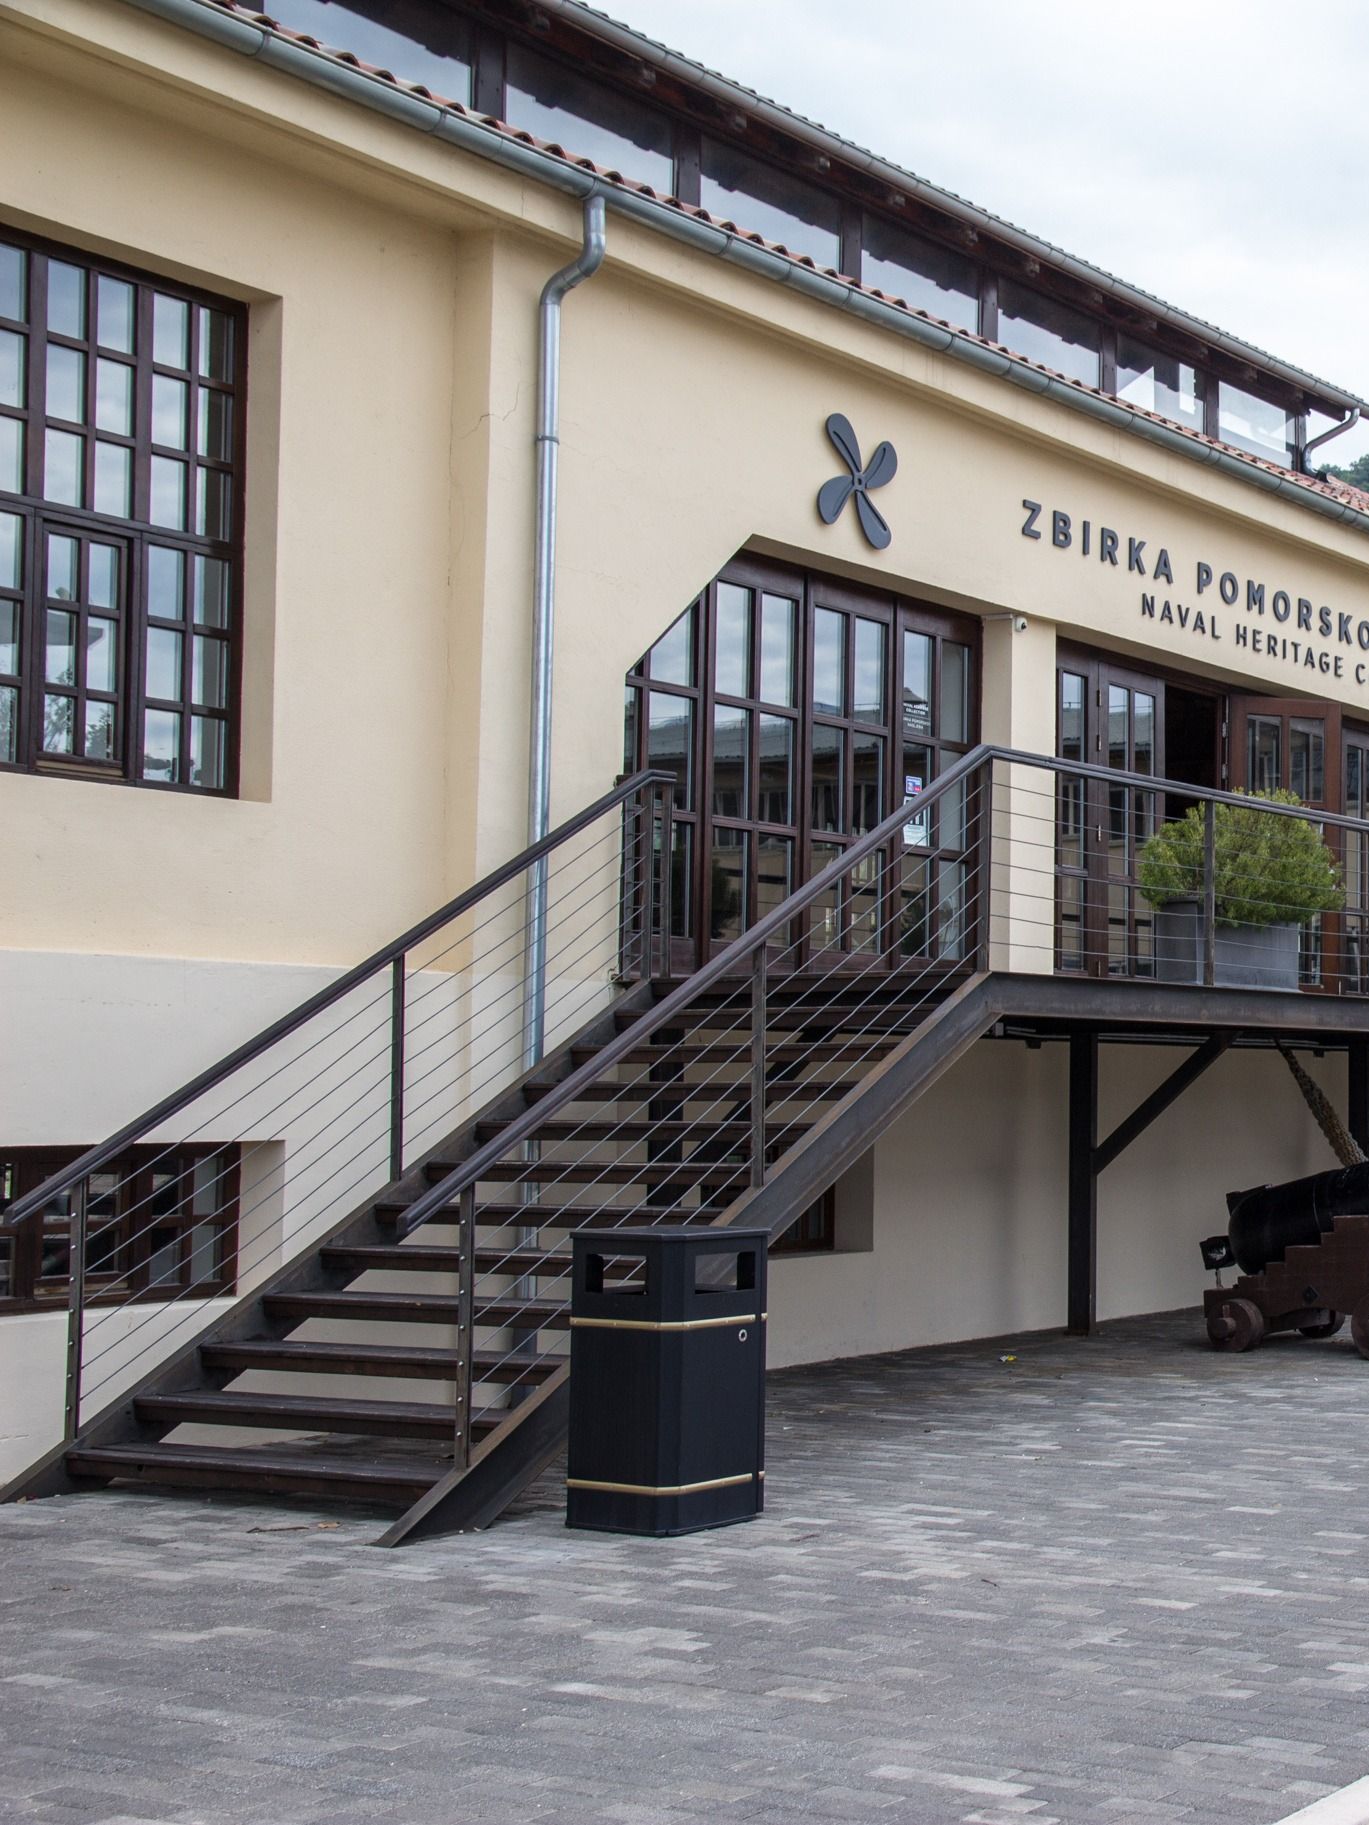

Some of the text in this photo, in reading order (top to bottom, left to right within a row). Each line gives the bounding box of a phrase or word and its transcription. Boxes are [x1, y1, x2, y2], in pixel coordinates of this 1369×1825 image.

[1022, 499, 1174, 585] ZBIRKA
[1141, 592, 1222, 640] NAVAL
[1235, 623, 1344, 678] HERITAGE
